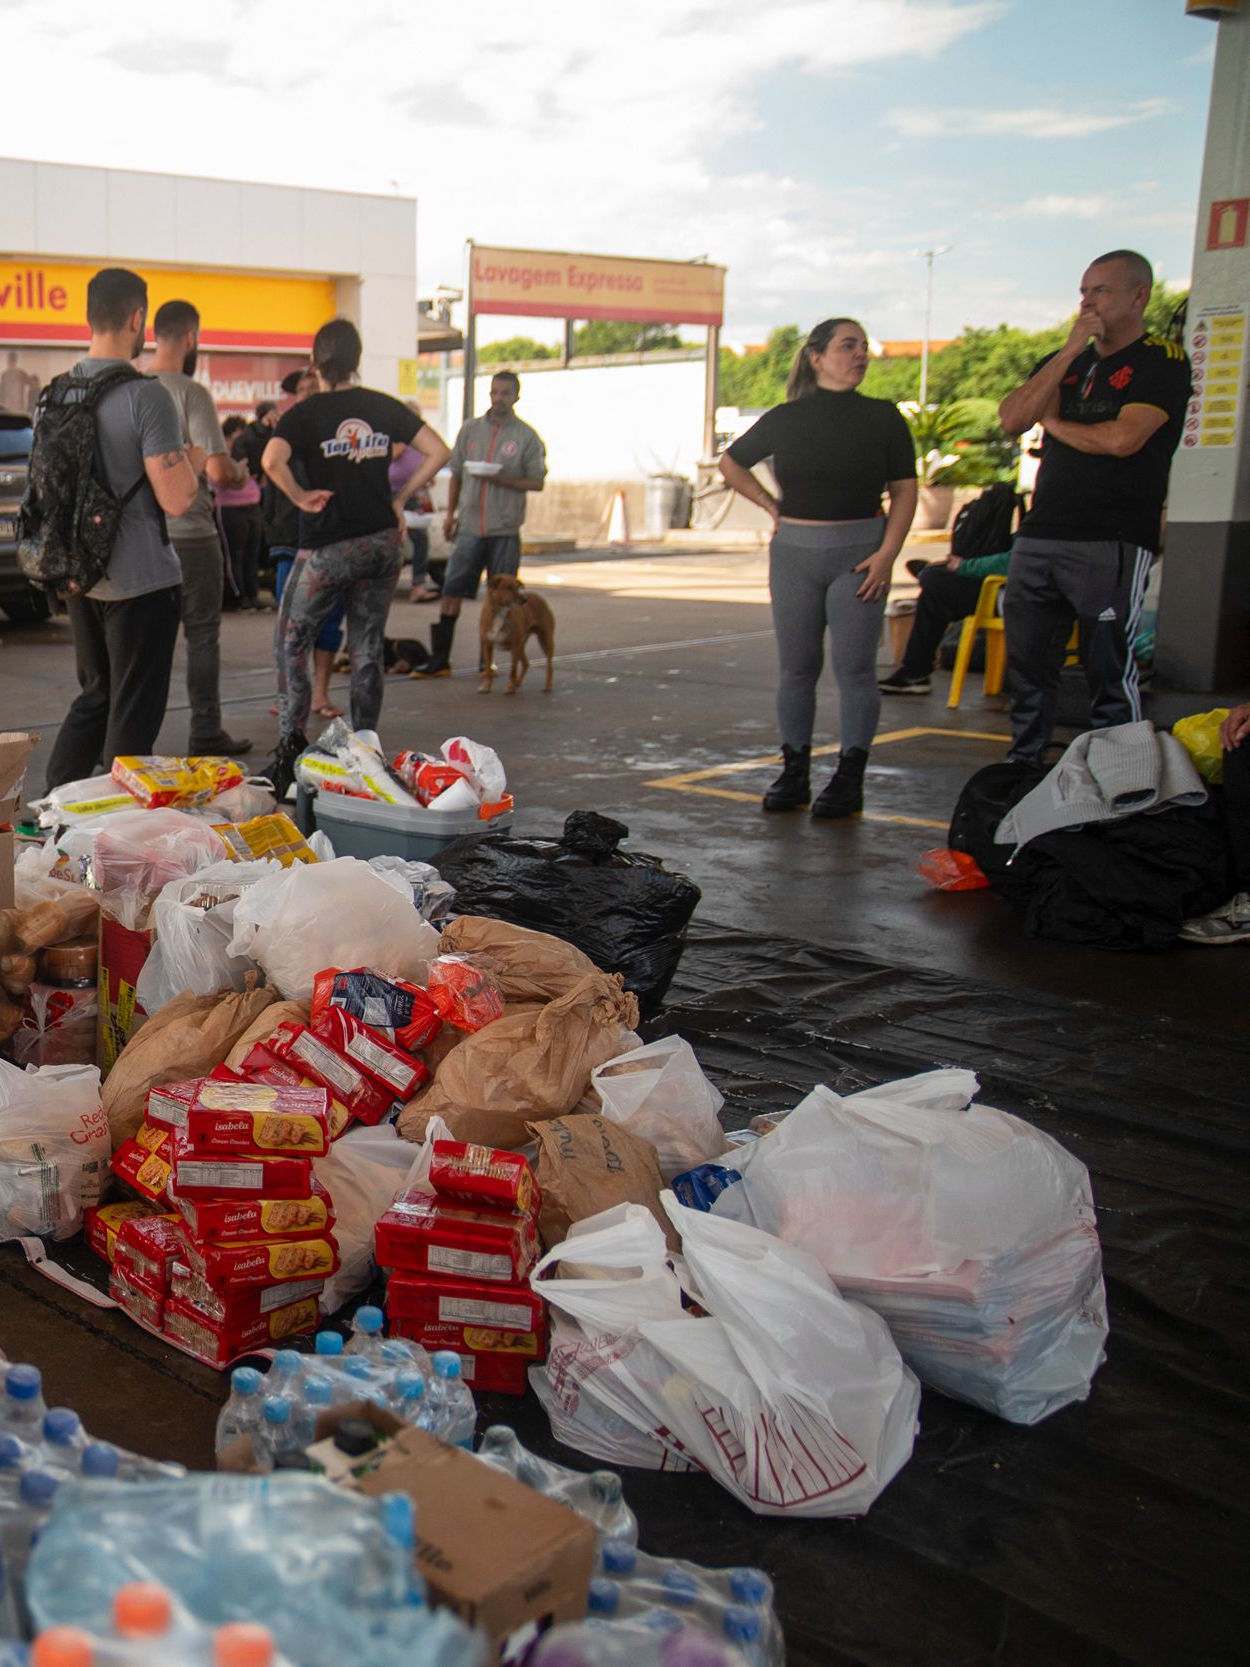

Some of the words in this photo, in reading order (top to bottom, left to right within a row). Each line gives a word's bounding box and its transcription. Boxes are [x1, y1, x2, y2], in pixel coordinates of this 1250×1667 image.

[473, 259, 561, 290] Lavagem
[215, 1120, 250, 1132] isabela
[224, 1209, 258, 1224] isabela
[233, 1256, 266, 1271] isabela
